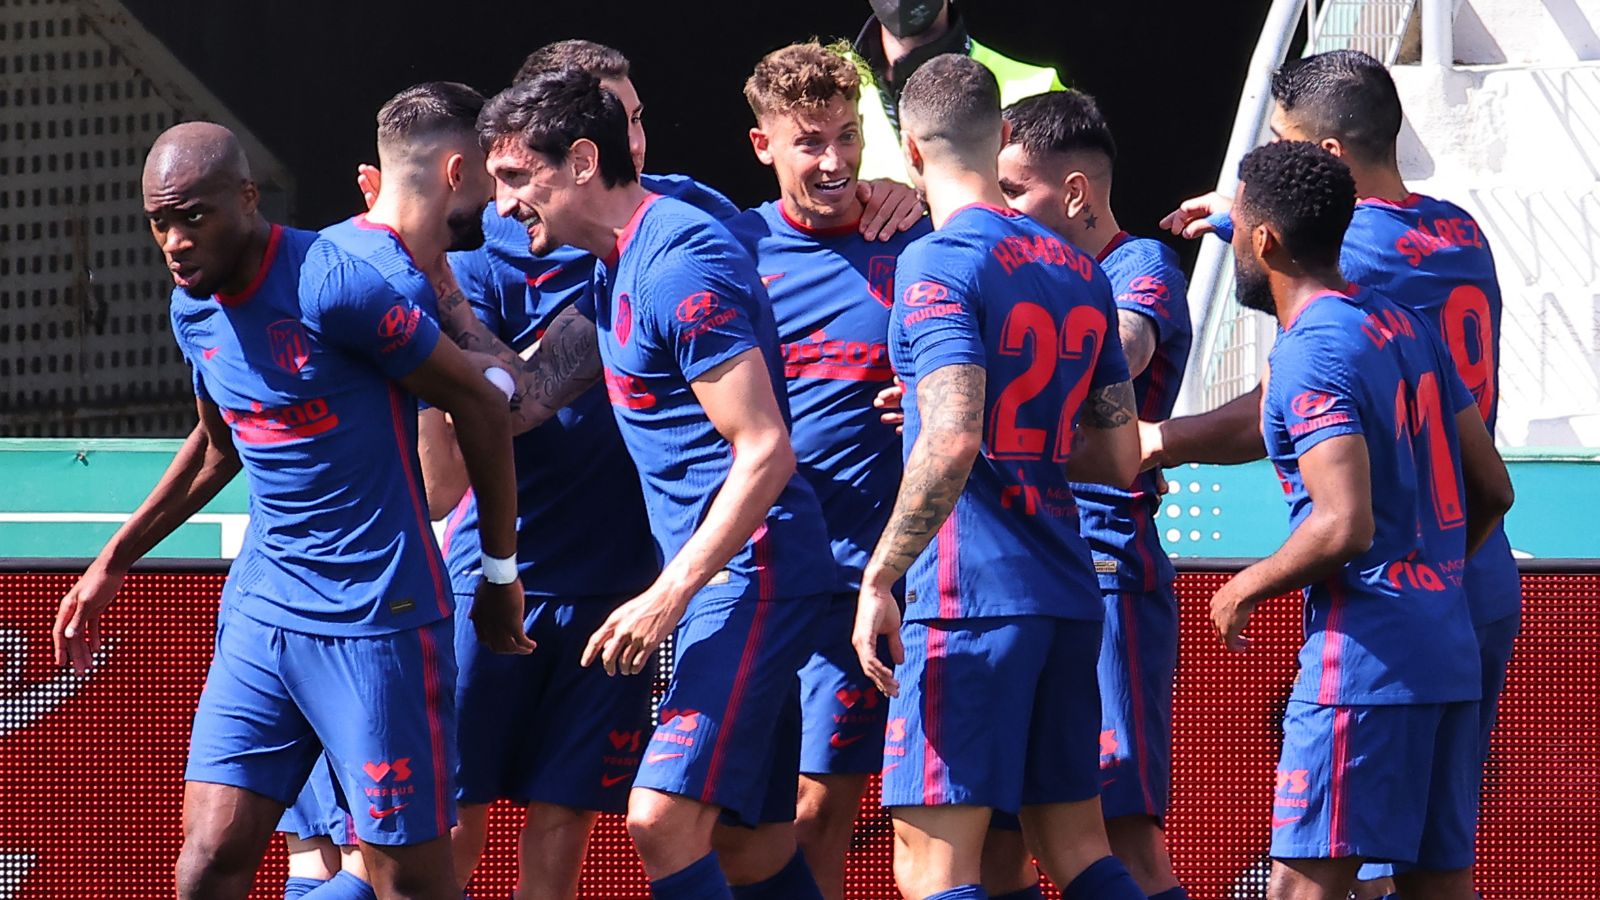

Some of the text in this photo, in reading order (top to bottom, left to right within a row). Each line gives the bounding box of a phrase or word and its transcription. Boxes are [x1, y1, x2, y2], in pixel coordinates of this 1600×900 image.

[1395, 218, 1482, 267] SUÁREZ
[904, 303, 963, 328] HYUNDAI
[1441, 285, 1495, 425] 9
[988, 301, 1107, 462] 22
[1289, 412, 1349, 436] HYUNDAI
[1388, 549, 1446, 591] ria
[364, 785, 414, 797] VERSUS
